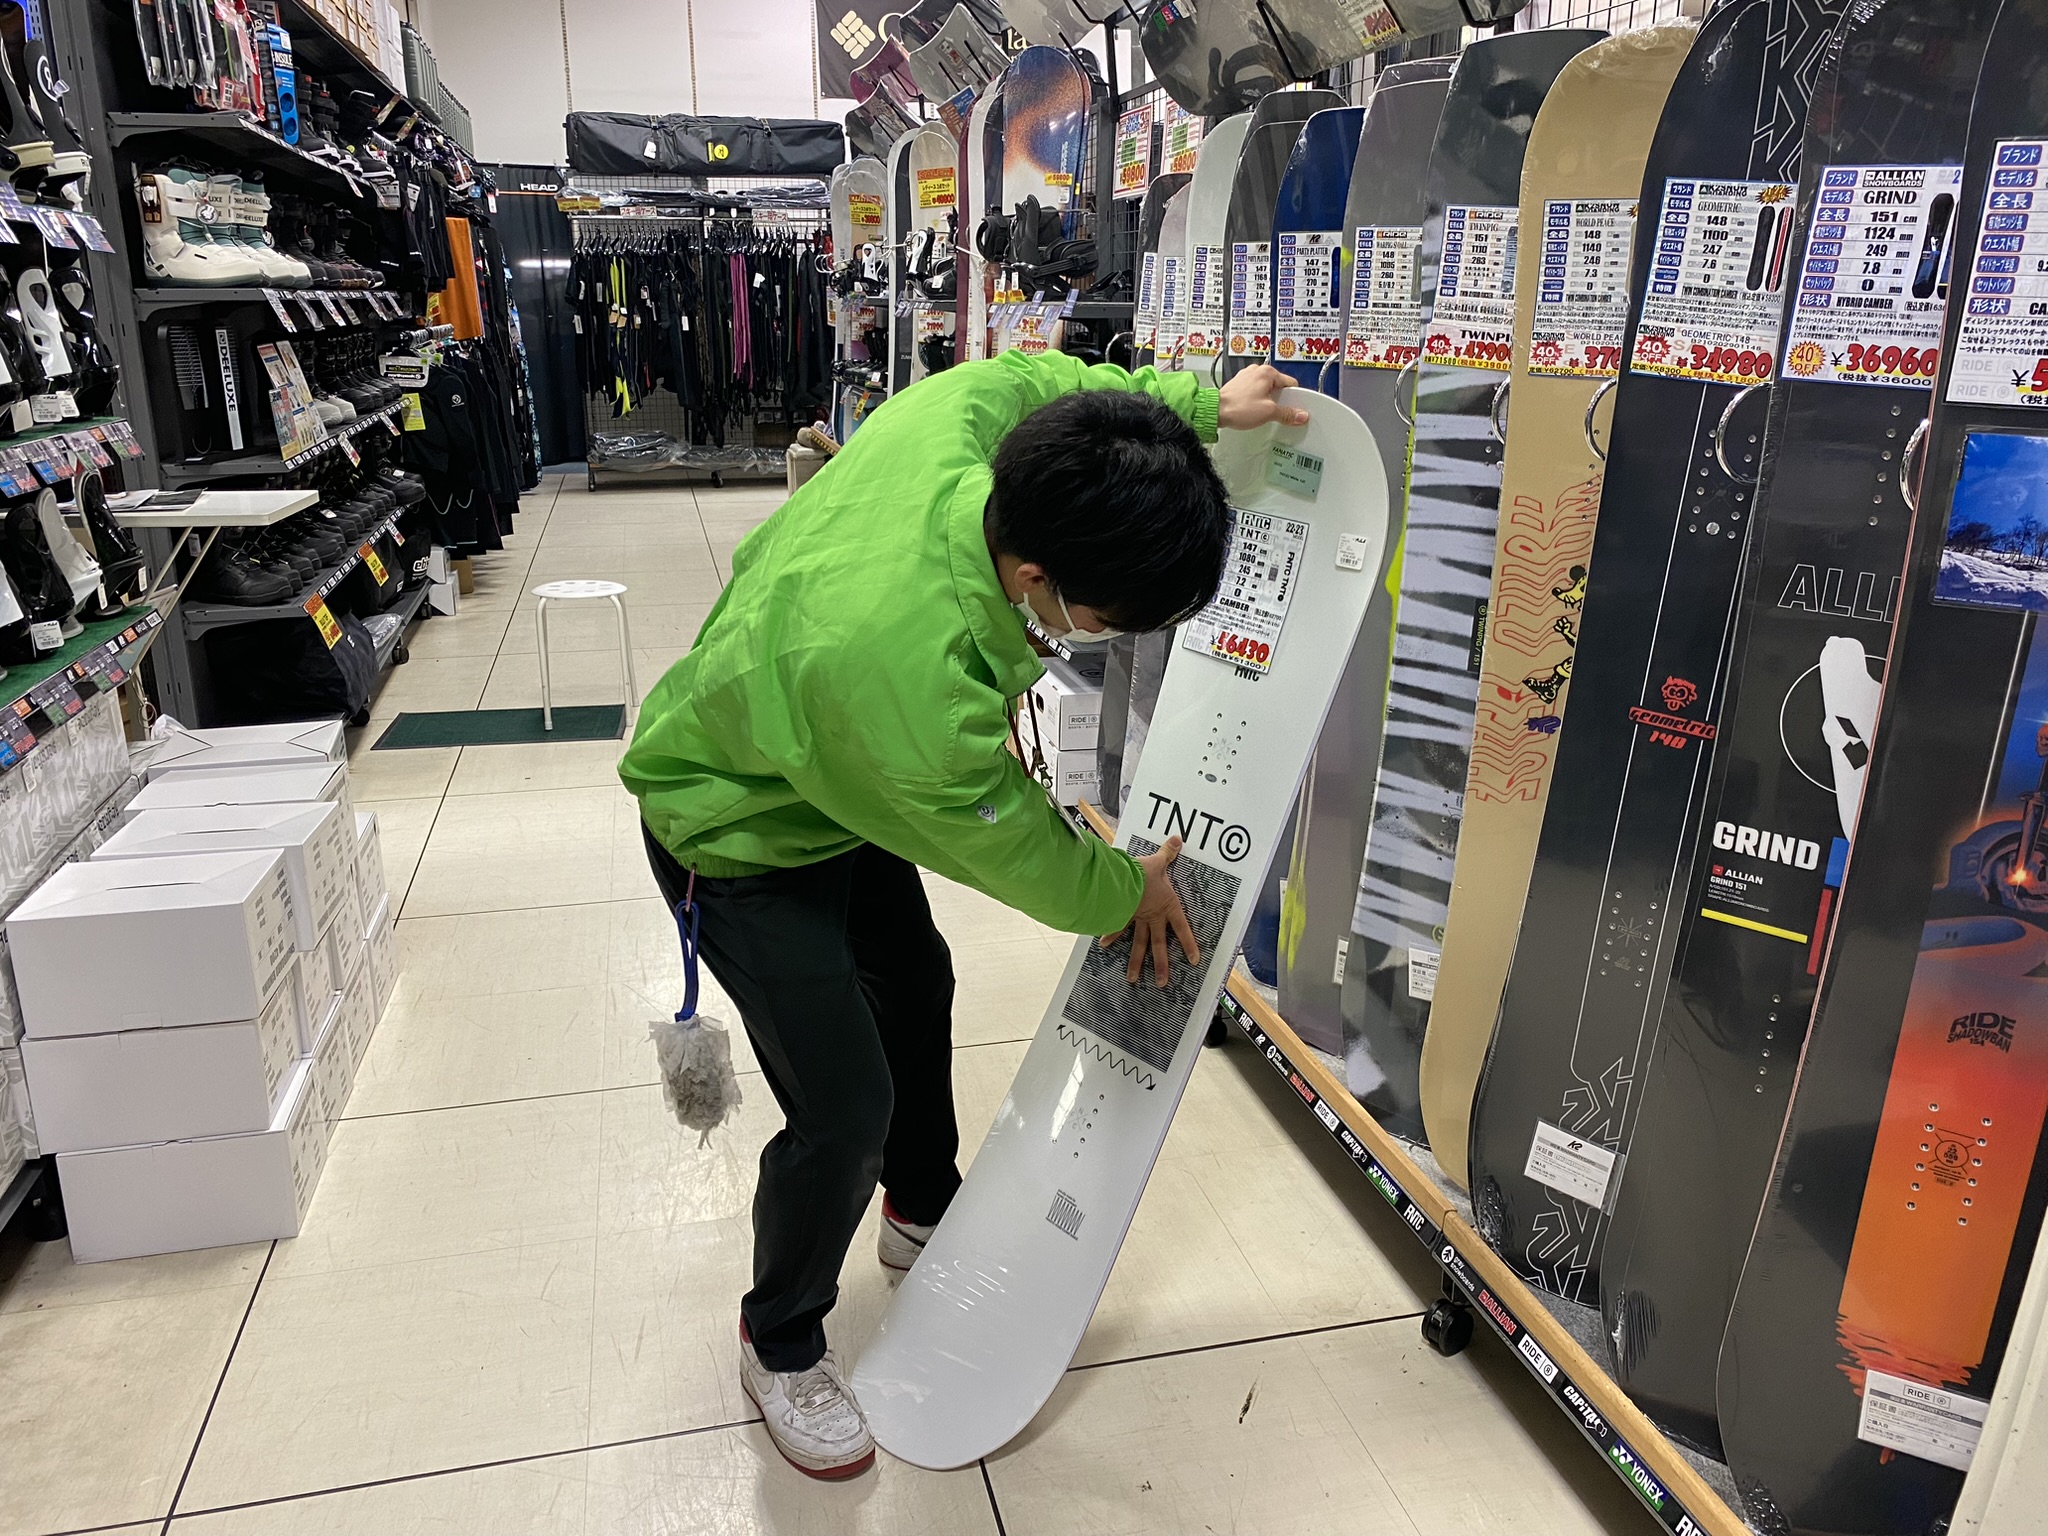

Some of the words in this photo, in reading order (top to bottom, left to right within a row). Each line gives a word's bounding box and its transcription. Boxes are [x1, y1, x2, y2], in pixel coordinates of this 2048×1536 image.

[2003, 148, 2039, 163] ブランド
[1828, 173, 1855, 184] ブランド
[1875, 171, 1924, 181] ALLIAN
[1998, 171, 2034, 185] モデル名
[520, 183, 558, 191] HEAD
[1672, 185, 1692, 194] ブランド
[1824, 192, 1851, 202] モデル名
[1864, 191, 1917, 204] GRIND
[1993, 193, 2028, 208] 全長
[1670, 199, 1690, 208] モデル名
[1697, 201, 1742, 213] GEOMETRIC
[1666, 213, 1687, 223] 全長
[1707, 215, 1728, 226] 148
[1820, 209, 1846, 221] 全長
[1870, 212, 1899, 222] 151
[1903, 215, 1917, 223] cm
[1988, 215, 2023, 229] 有効エッジ長
[1469, 223, 1499, 231] TWINPIG
[1309, 234, 1321, 243] K2
[1474, 233, 1488, 242] 151
[1548, 230, 1567, 239] 全長
[1584, 230, 1601, 239] 148
[1702, 230, 1729, 241] 1100
[1864, 227, 1896, 240] 1124
[1899, 233, 1913, 241] mm
[1471, 245, 1487, 254] 1110
[1582, 243, 1601, 252] 1140
[1702, 244, 1723, 255] 247
[1985, 236, 2020, 251] ウエスト幅
[1310, 247, 1328, 256] PLATTER
[1812, 245, 1840, 256] ウエスト幅
[1865, 244, 1887, 257] 249
[1471, 256, 1486, 265] 263
[1583, 256, 1601, 265] 246
[1701, 259, 1717, 269] 7.6
[1584, 268, 1597, 277] 7.3
[1862, 262, 1880, 275] 7.8
[1703, 274, 1711, 284] 0
[1805, 279, 1832, 289] セットバック
[1862, 279, 1875, 291] 0
[1977, 279, 2012, 292] セットバック
[1586, 282, 1593, 290] 0
[1801, 295, 1828, 306] 形状
[1836, 296, 1862, 308] HYBRID
[1863, 298, 1893, 310] CAMBER
[1972, 299, 2006, 314] 形状
[2029, 302, 2048, 315] CA
[1460, 329, 1512, 343] TWINPI
[1681, 329, 1731, 342] GEOMETRIC
[1735, 335, 1751, 344] 148
[1641, 353, 1662, 361] OFF
[1794, 363, 1819, 372] OFF
[1220, 346, 1236, 412] DEELUXE
[1243, 542, 1258, 552] 147
[1239, 552, 1256, 564] 1080
[1283, 551, 1295, 576] FNTC
[1239, 564, 1251, 576] 245
[1235, 576, 1245, 587] 7.2
[1234, 588, 1241, 598] 0
[1219, 597, 1250, 613] CAMBER
[1475, 617, 1485, 647] TWINPIG
[1649, 731, 1688, 749] 148
[1712, 820, 1821, 871] GRIND
[1710, 875, 1734, 888] GRIND
[1735, 882, 1747, 891] 151
[1724, 869, 1764, 885] ALLIAN
[1951, 1012, 2017, 1040] RIDE
[1946, 1026, 2012, 1053] SHADOWBAN
[1969, 1037, 1985, 1047] 154
[1317, 1103, 1330, 1120] RIDE
[1567, 1140, 1583, 1151] K2
[1378, 1174, 1400, 1201] YONEX
[1404, 1203, 1425, 1231] FNTC
[1453, 1255, 1465, 1270] gray
[1450, 1262, 1476, 1293] snowboards
[1485, 1296, 1517, 1335] ALLIAN
[1521, 1339, 1543, 1365] RIDE
[1907, 1388, 1931, 1400] RIDE
[1629, 1461, 1664, 1504] YONEX
